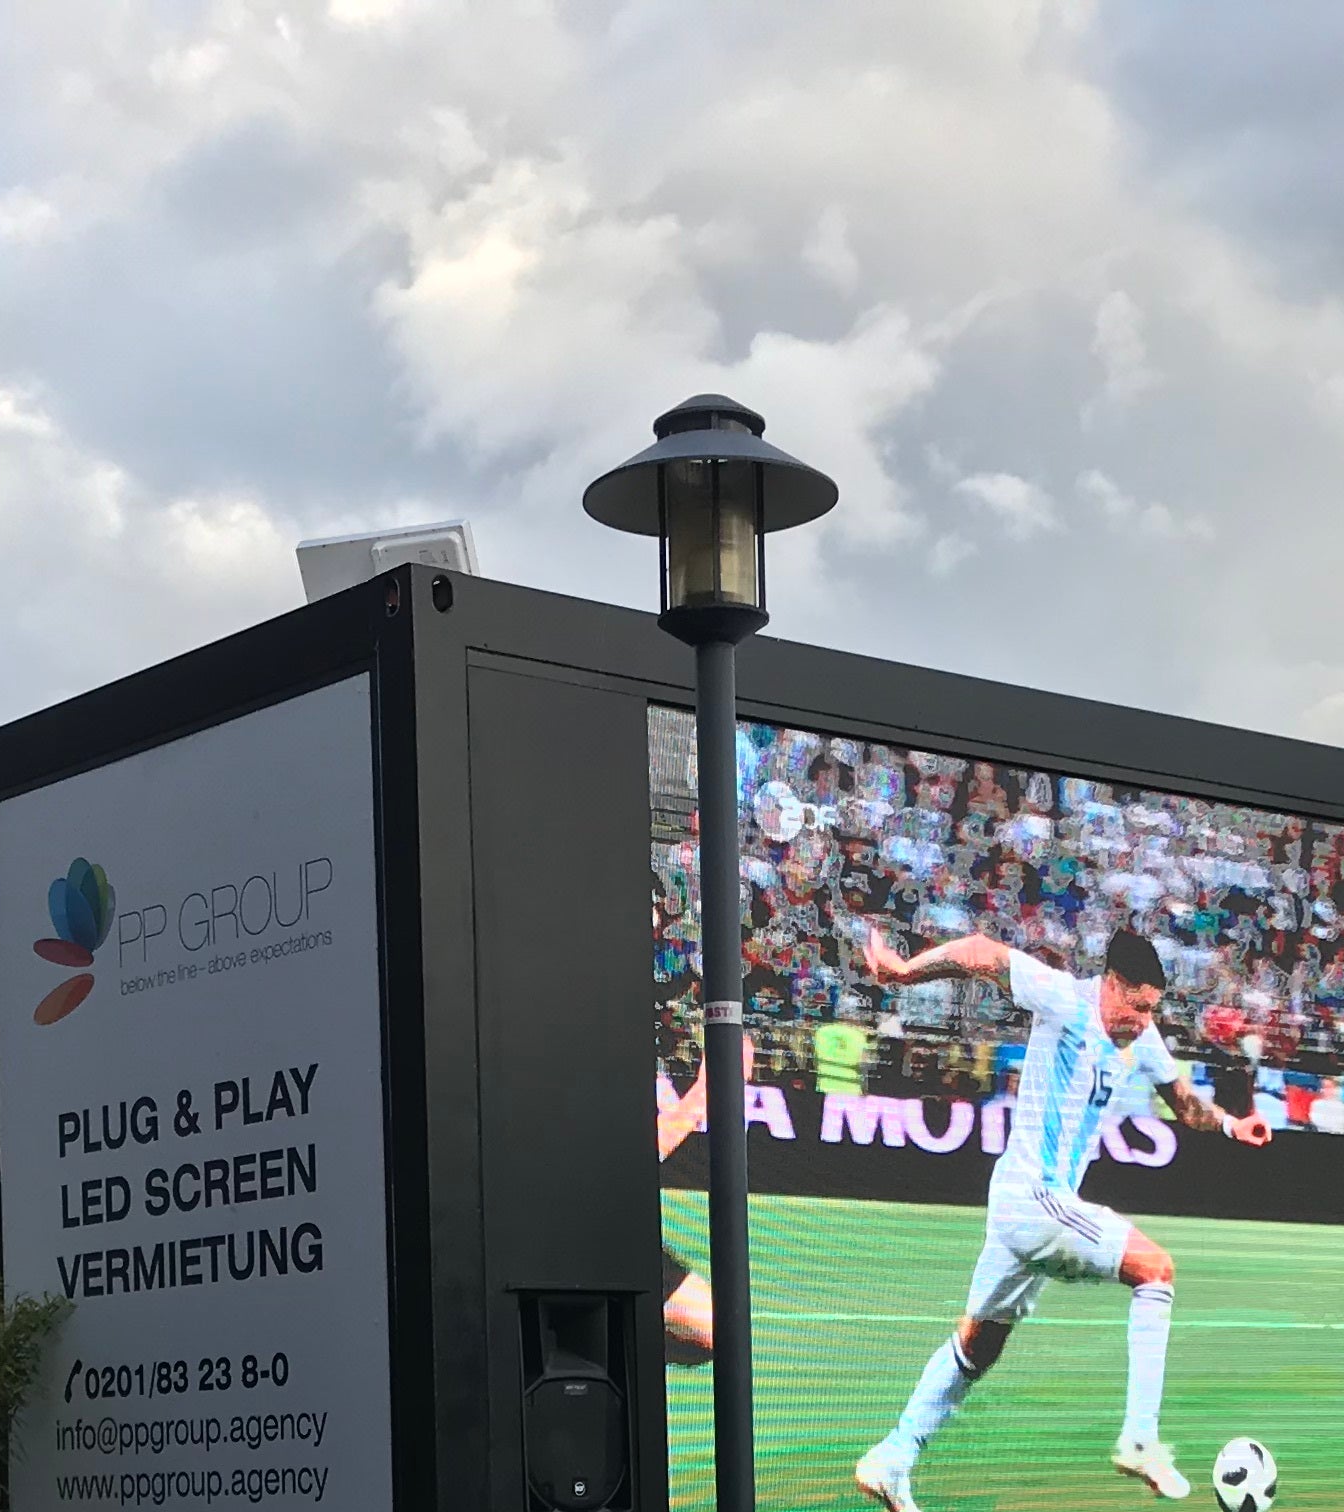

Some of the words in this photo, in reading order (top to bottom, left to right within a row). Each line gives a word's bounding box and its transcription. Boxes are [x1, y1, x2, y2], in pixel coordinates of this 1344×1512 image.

[118, 904, 167, 968] PP
[178, 857, 333, 951] GROUP
[120, 973, 155, 996] below
[156, 968, 176, 987] the
[177, 962, 197, 981] line
[208, 950, 247, 975] above
[250, 930, 333, 964] expectations
[58, 1096, 159, 1158] PLUG
[173, 1089, 201, 1137] &
[215, 1063, 319, 1130] PLAY
[1088, 1064, 1113, 1107] 15
[61, 1175, 130, 1229] LED
[144, 1143, 317, 1217] SCREEN
[57, 1222, 324, 1299] VERMIETUNG
[85, 1360, 189, 1400] 0201/83
[199, 1356, 232, 1392] 23
[242, 1352, 289, 1388] 8-0
[57, 1411, 328, 1456] info@ppgroup.agency
[57, 1465, 329, 1506] www.ppgroup.agency
